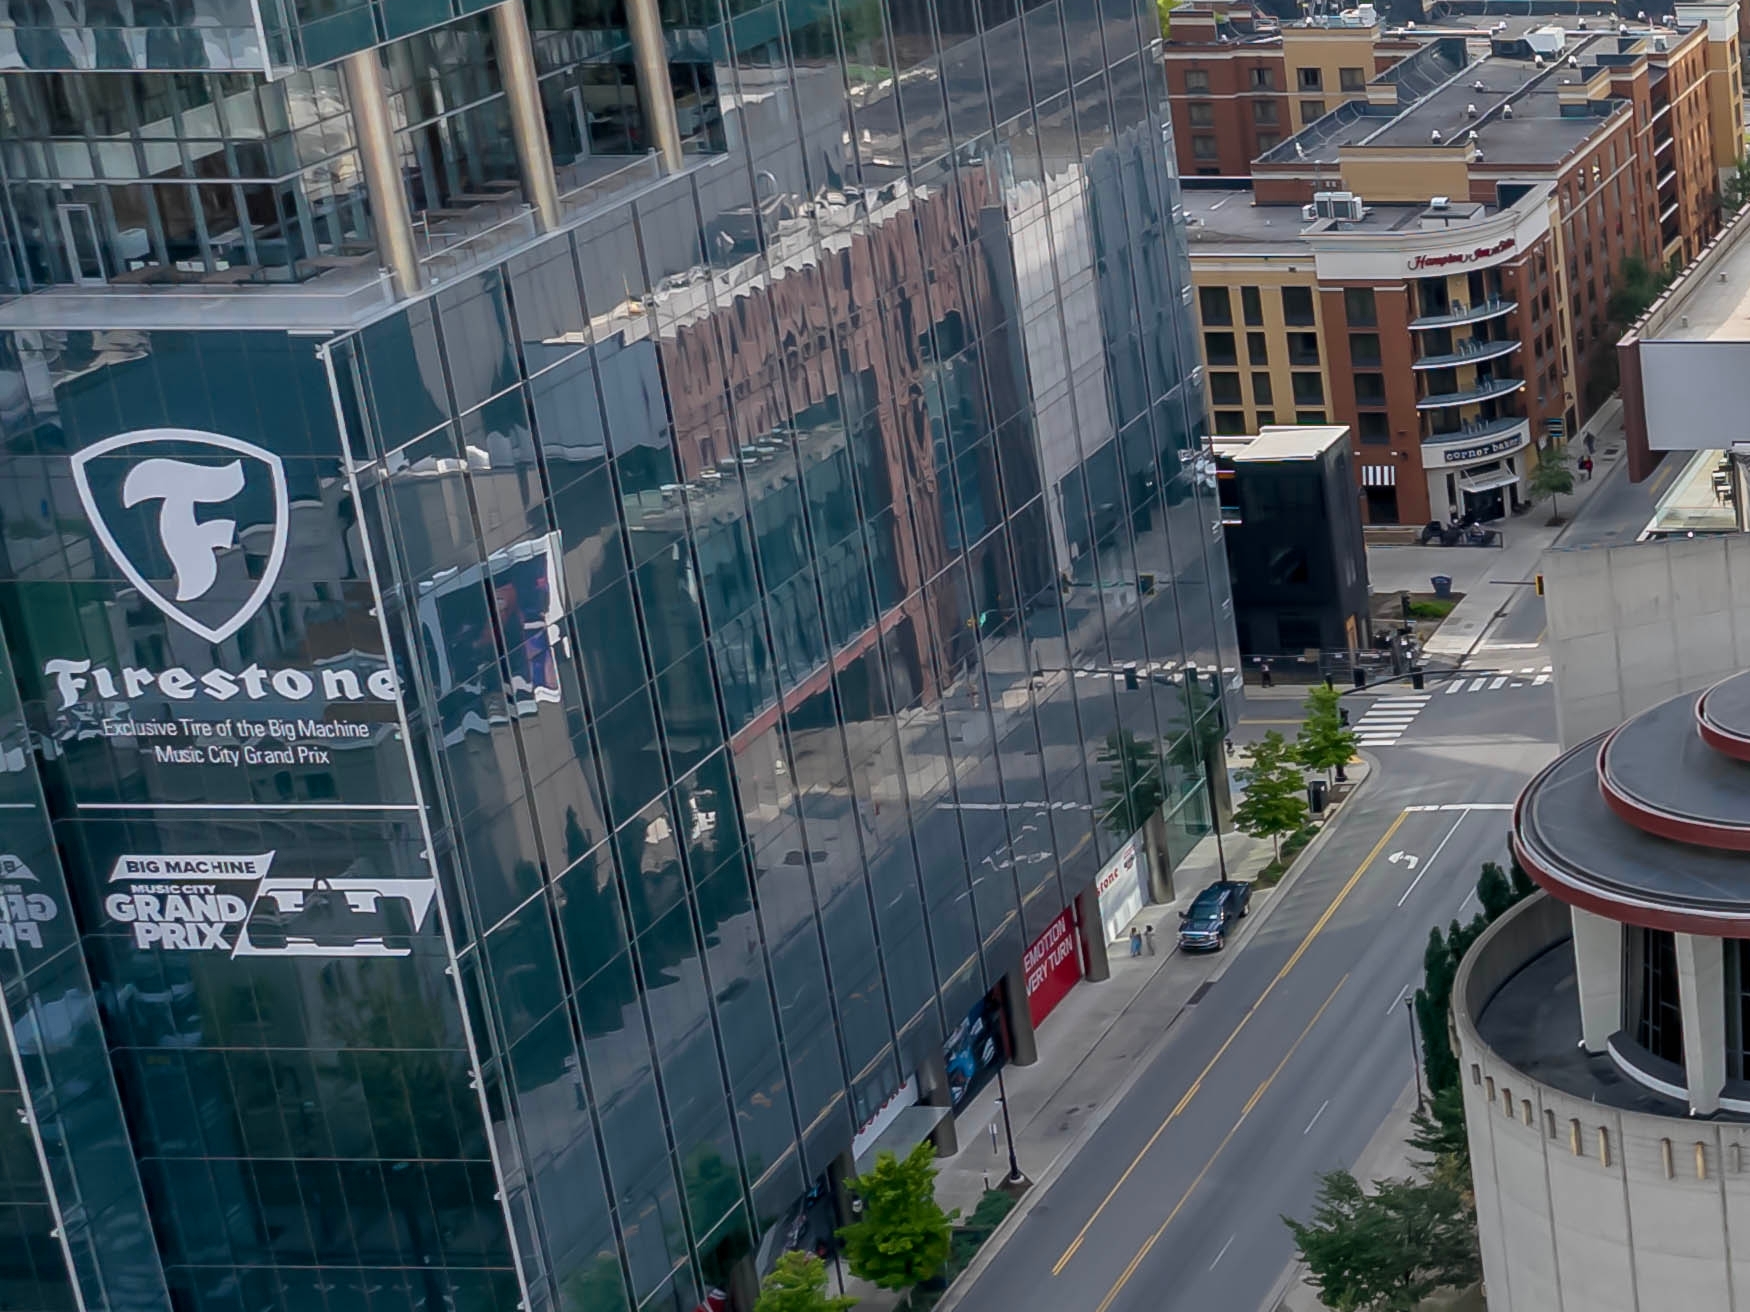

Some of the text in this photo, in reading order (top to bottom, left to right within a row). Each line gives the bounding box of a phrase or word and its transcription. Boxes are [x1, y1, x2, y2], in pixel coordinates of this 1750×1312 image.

[1446, 447, 1489, 461] corner
[44, 658, 404, 712] Firestone
[102, 718, 370, 741] Exclusive Tire of the Big Machine
[155, 746, 330, 767] Music City Grand Prix
[126, 860, 257, 875] BIG MACHINE
[131, 884, 216, 895] MUSIC CITY
[1097, 868, 1119, 897] tone
[105, 893, 248, 923] GRAND
[131, 921, 233, 950] PRIX
[1024, 916, 1066, 973] EMOTION
[1026, 934, 1073, 997] VERY TURN
